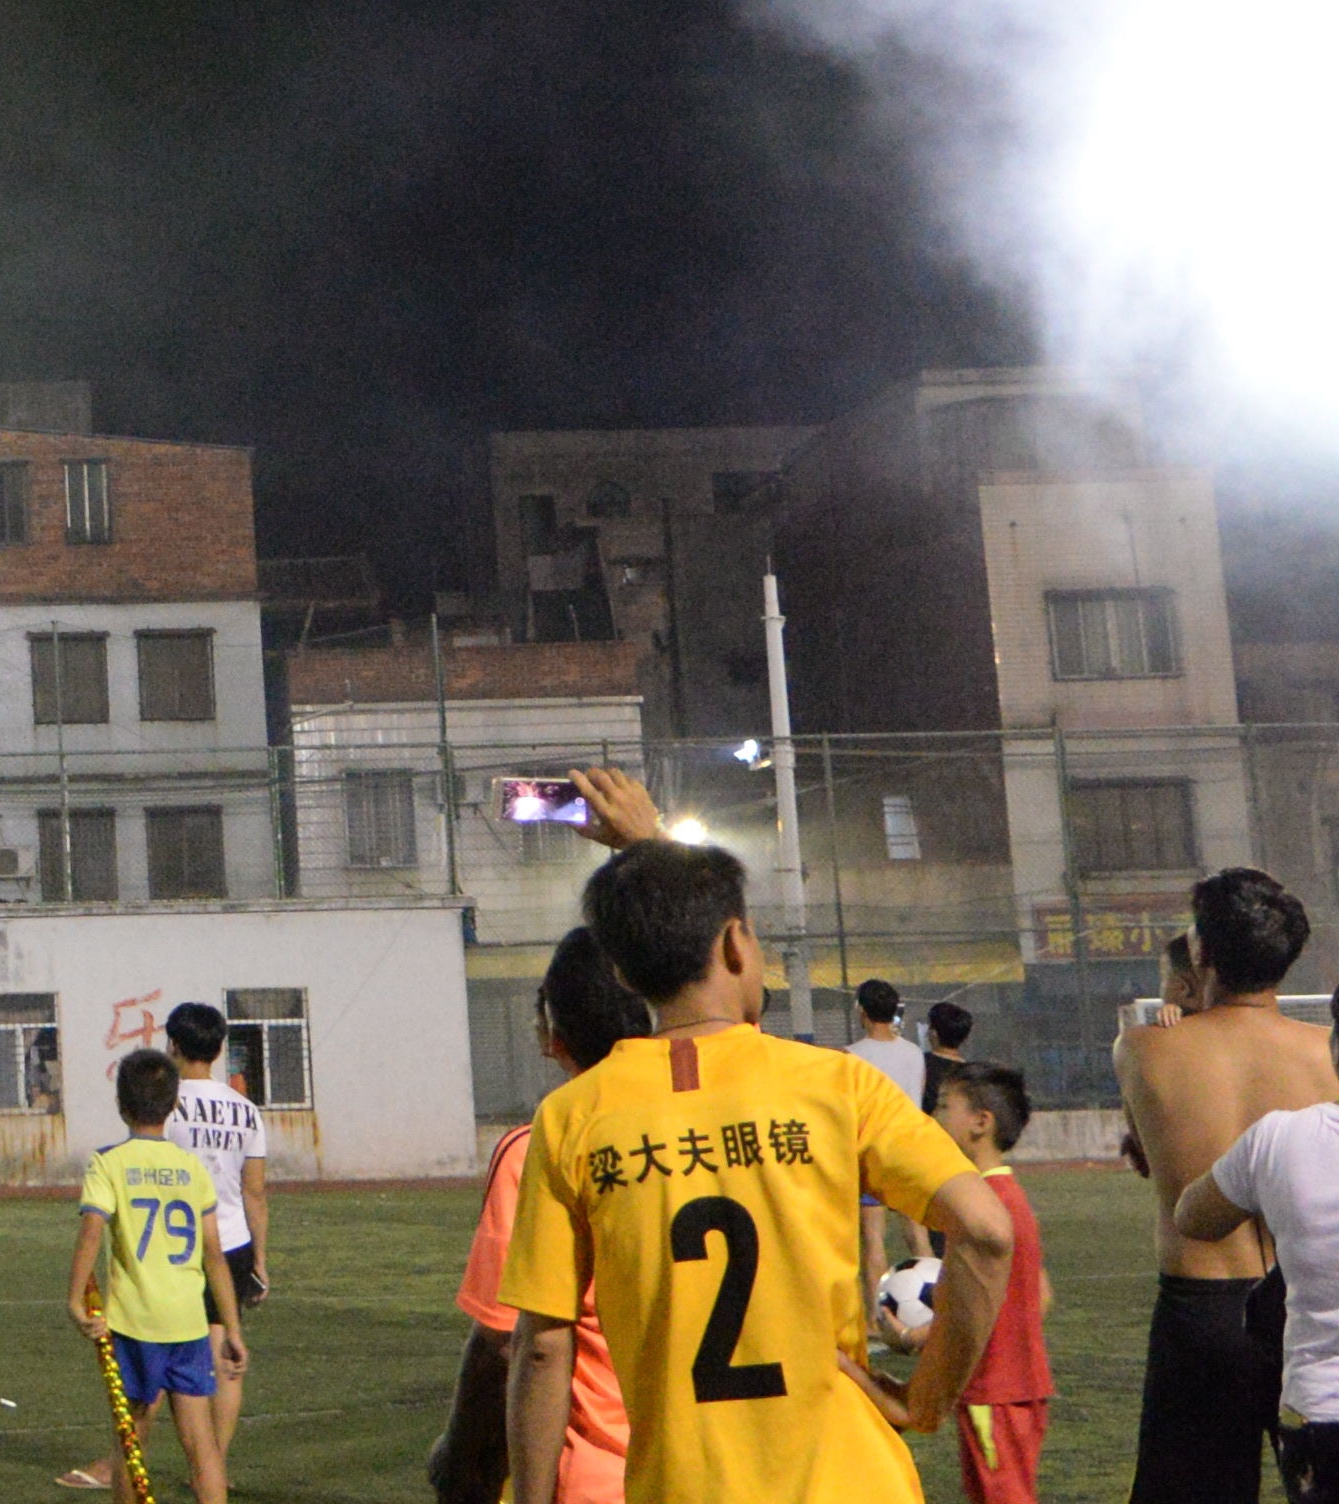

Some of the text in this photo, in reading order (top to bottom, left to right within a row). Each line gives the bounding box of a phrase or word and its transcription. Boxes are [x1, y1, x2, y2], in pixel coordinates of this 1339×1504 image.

[588, 1118, 814, 1195] 梁大夫眼镜
[130, 1197, 197, 1265] 79
[670, 1195, 788, 1405] 2
